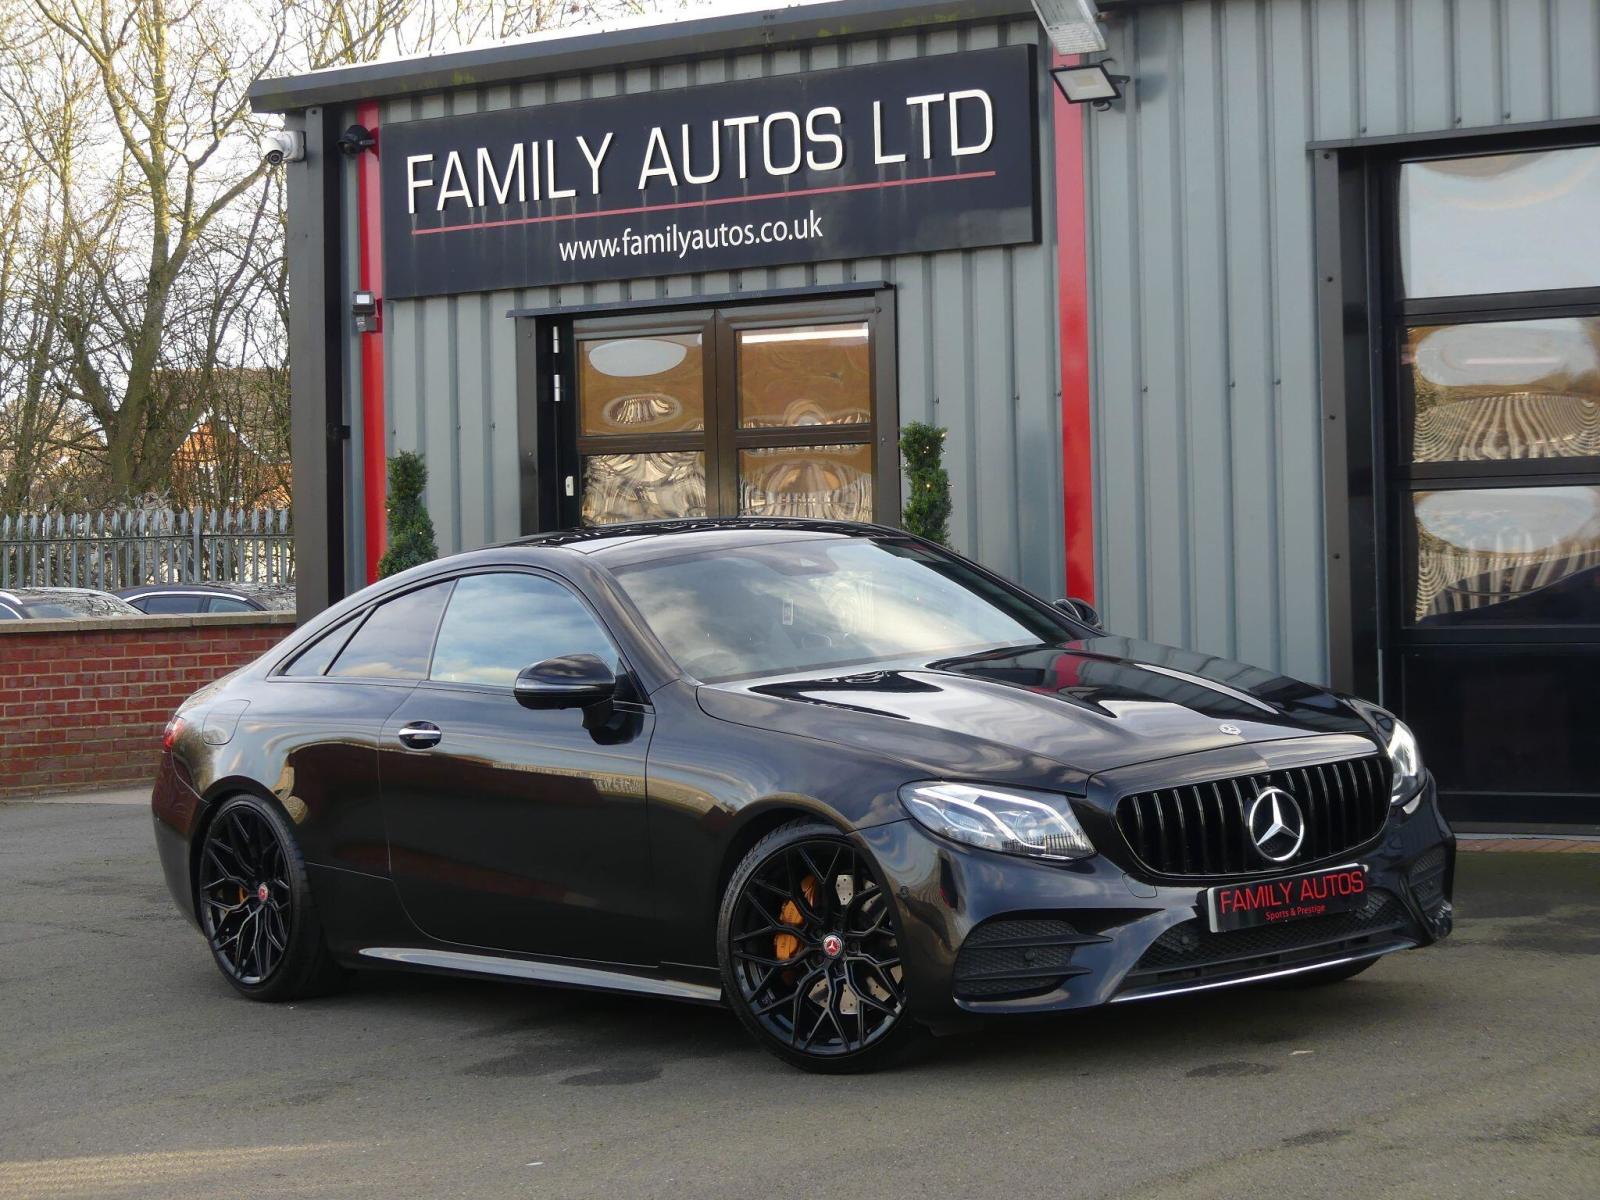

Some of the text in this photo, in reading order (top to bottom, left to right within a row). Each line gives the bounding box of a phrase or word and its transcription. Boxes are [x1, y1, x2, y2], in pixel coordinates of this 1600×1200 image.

[406, 88, 994, 215] FAMILY AUTOS LTD
[558, 209, 824, 262] www.familyautos.co.uk
[1219, 870, 1365, 914] FAMILY AUTOS
[1265, 904, 1326, 921] Sports & Prestige
